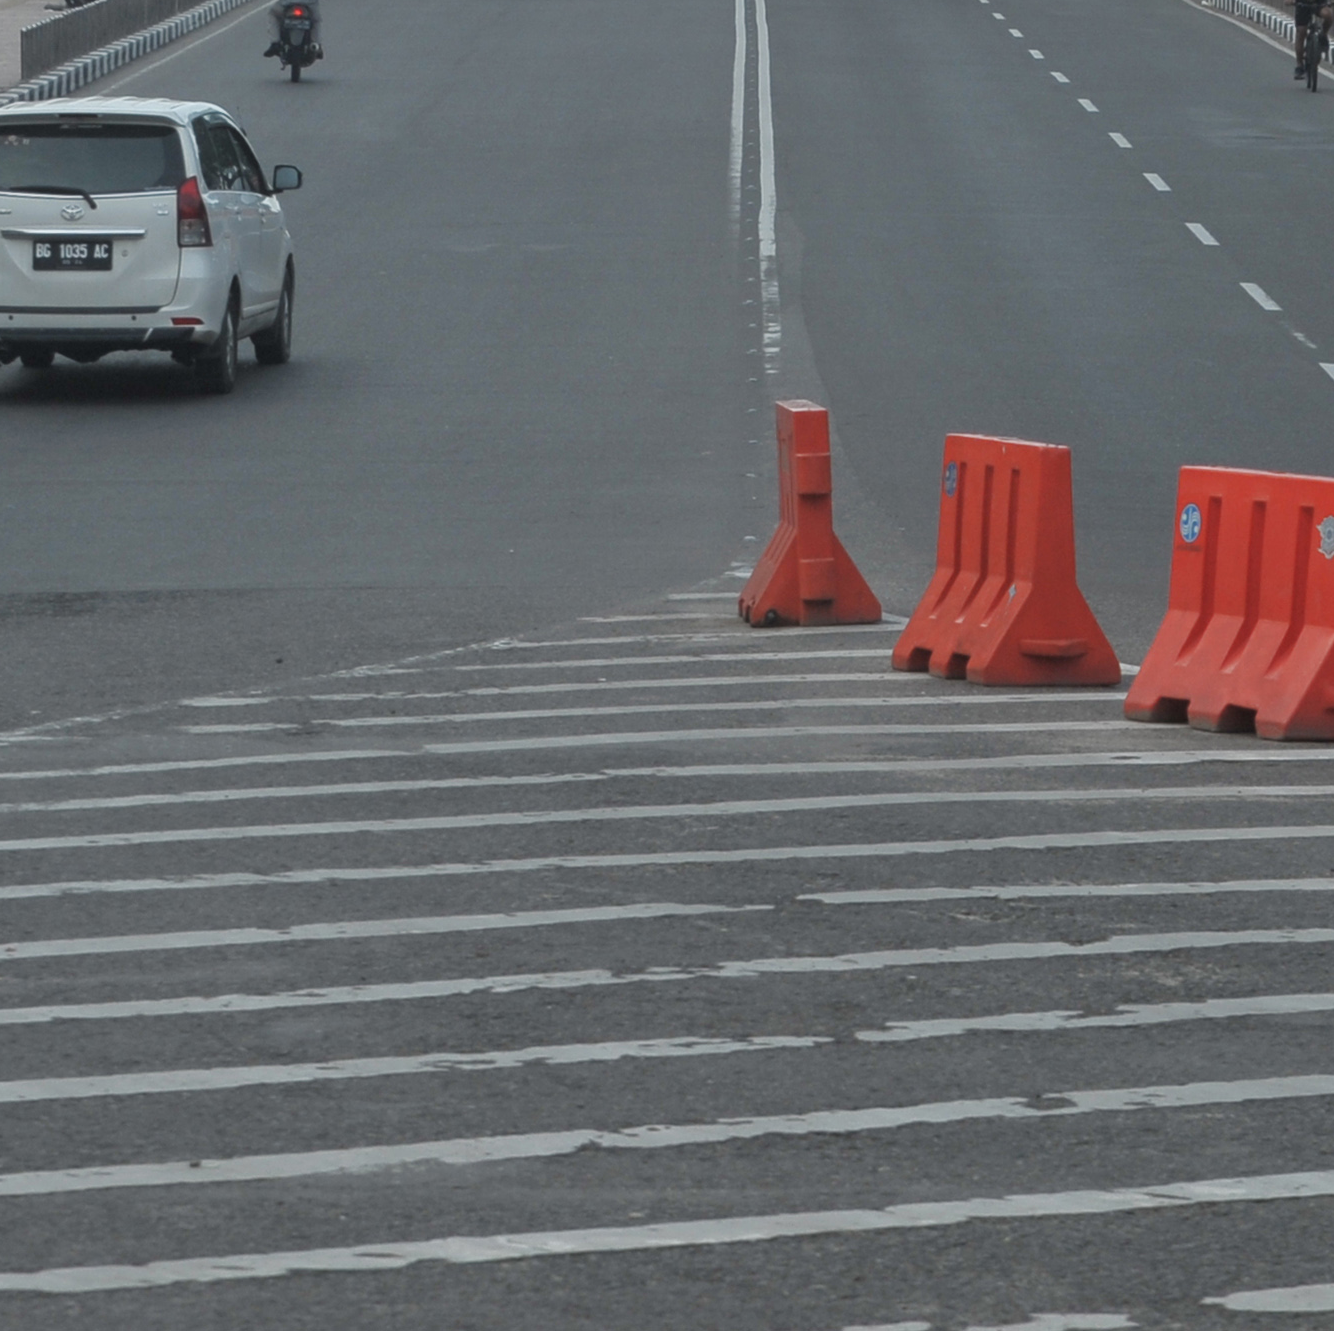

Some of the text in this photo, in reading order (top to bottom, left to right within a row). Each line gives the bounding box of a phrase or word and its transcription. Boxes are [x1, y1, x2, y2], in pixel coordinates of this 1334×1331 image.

[35, 243, 109, 259] BG 1035 AC
